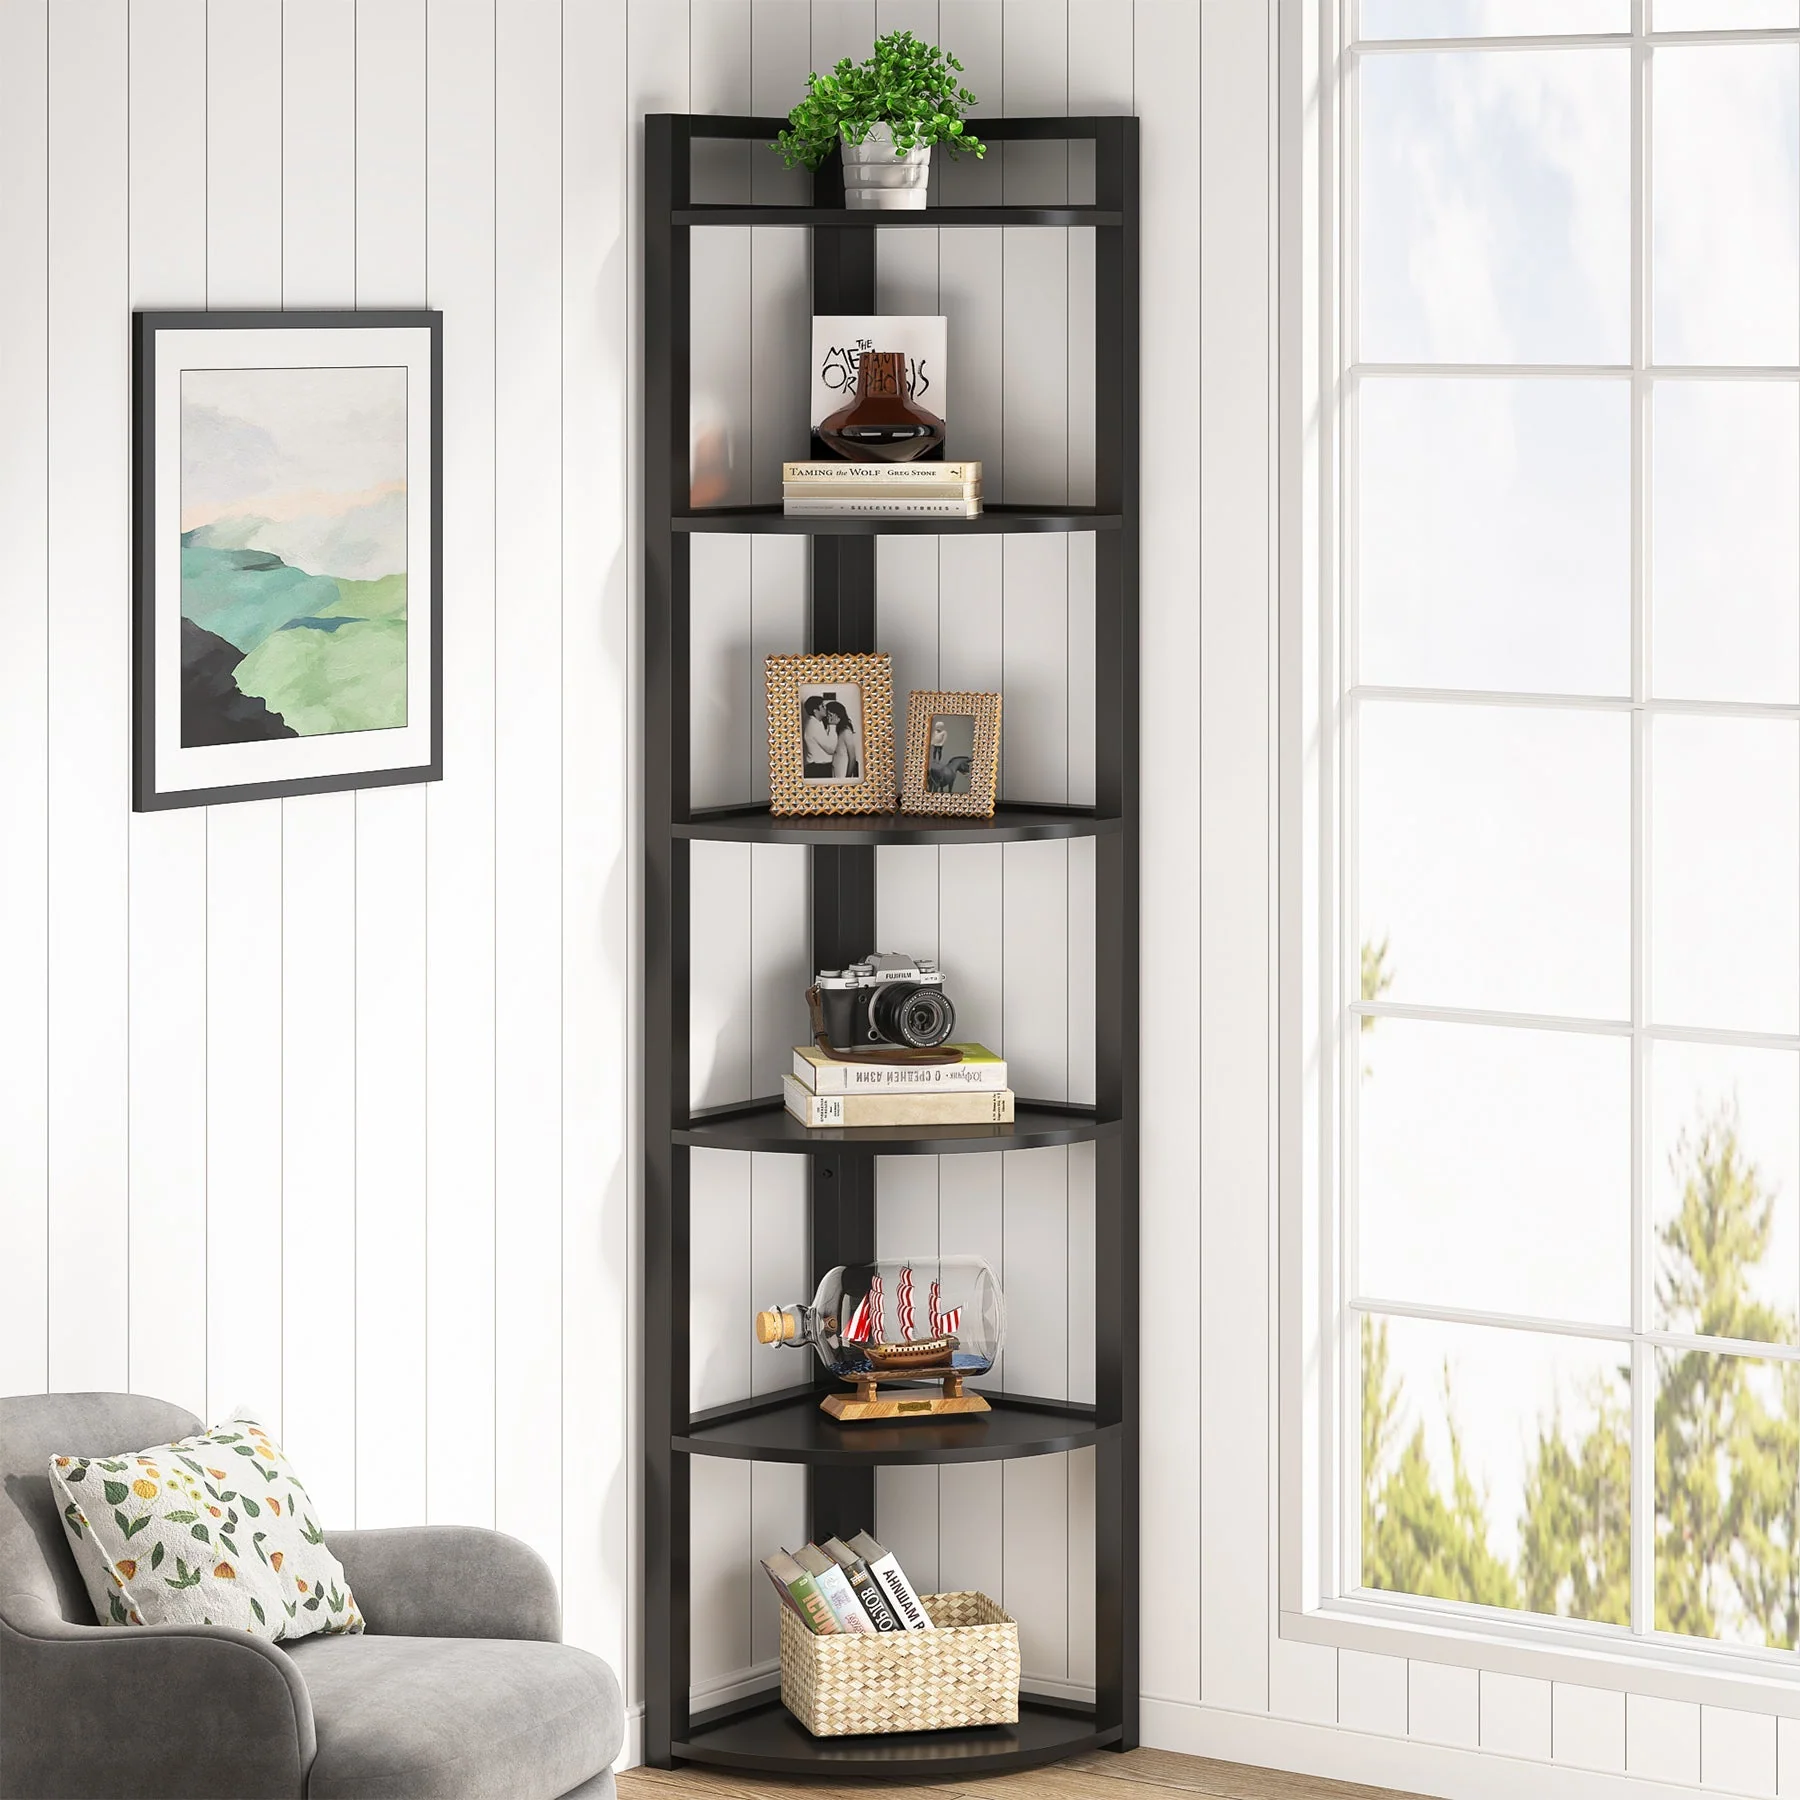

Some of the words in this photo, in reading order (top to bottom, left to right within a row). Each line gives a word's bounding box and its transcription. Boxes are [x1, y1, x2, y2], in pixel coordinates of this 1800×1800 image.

[856, 339, 873, 350] THE
[789, 467, 833, 476] TAMING
[849, 468, 881, 476] WOLF
[885, 972, 912, 980] FUJIFILM
[856, 1071, 883, 1083] АЗИИ
